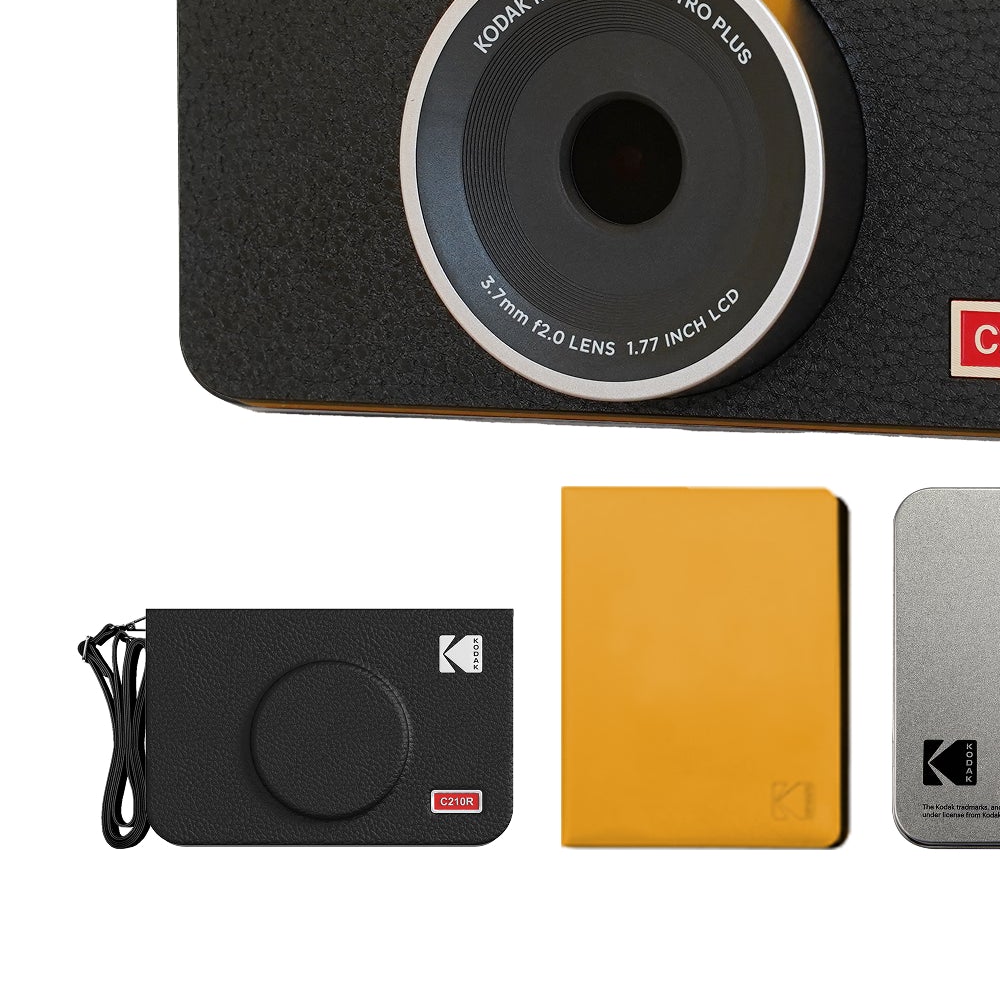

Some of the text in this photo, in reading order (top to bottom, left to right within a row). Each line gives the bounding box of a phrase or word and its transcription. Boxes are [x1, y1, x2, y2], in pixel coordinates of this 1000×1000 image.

[711, 15, 753, 66] PLUS
[480, 275, 740, 357] 3.7mm f2.0 LENS 1.77 INCH LCD
[439, 797, 474, 806] C210R
